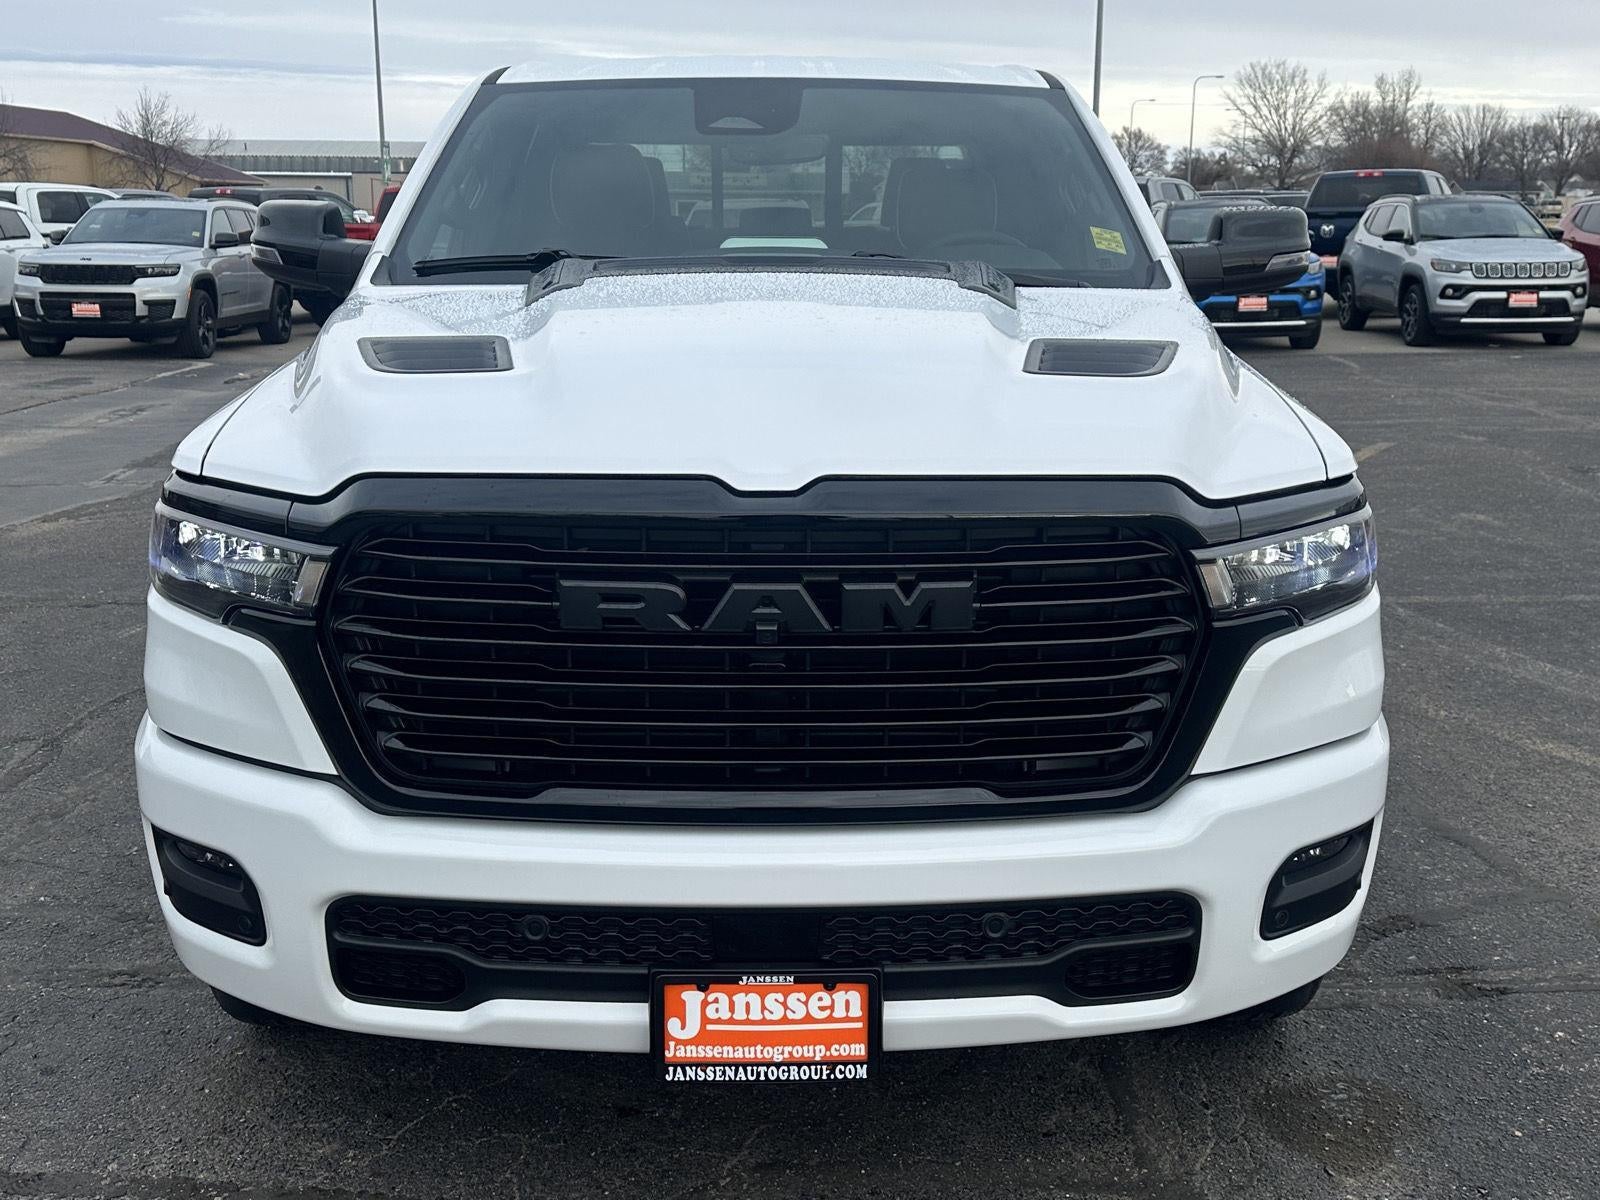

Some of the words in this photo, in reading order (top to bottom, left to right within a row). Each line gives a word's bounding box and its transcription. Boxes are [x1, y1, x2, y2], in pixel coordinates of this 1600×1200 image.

[557, 579, 976, 632] RAM
[738, 975, 794, 985] JANSSEN
[667, 990, 863, 1040] Janssen
[665, 1041, 866, 1062] Janssenautogroup.com
